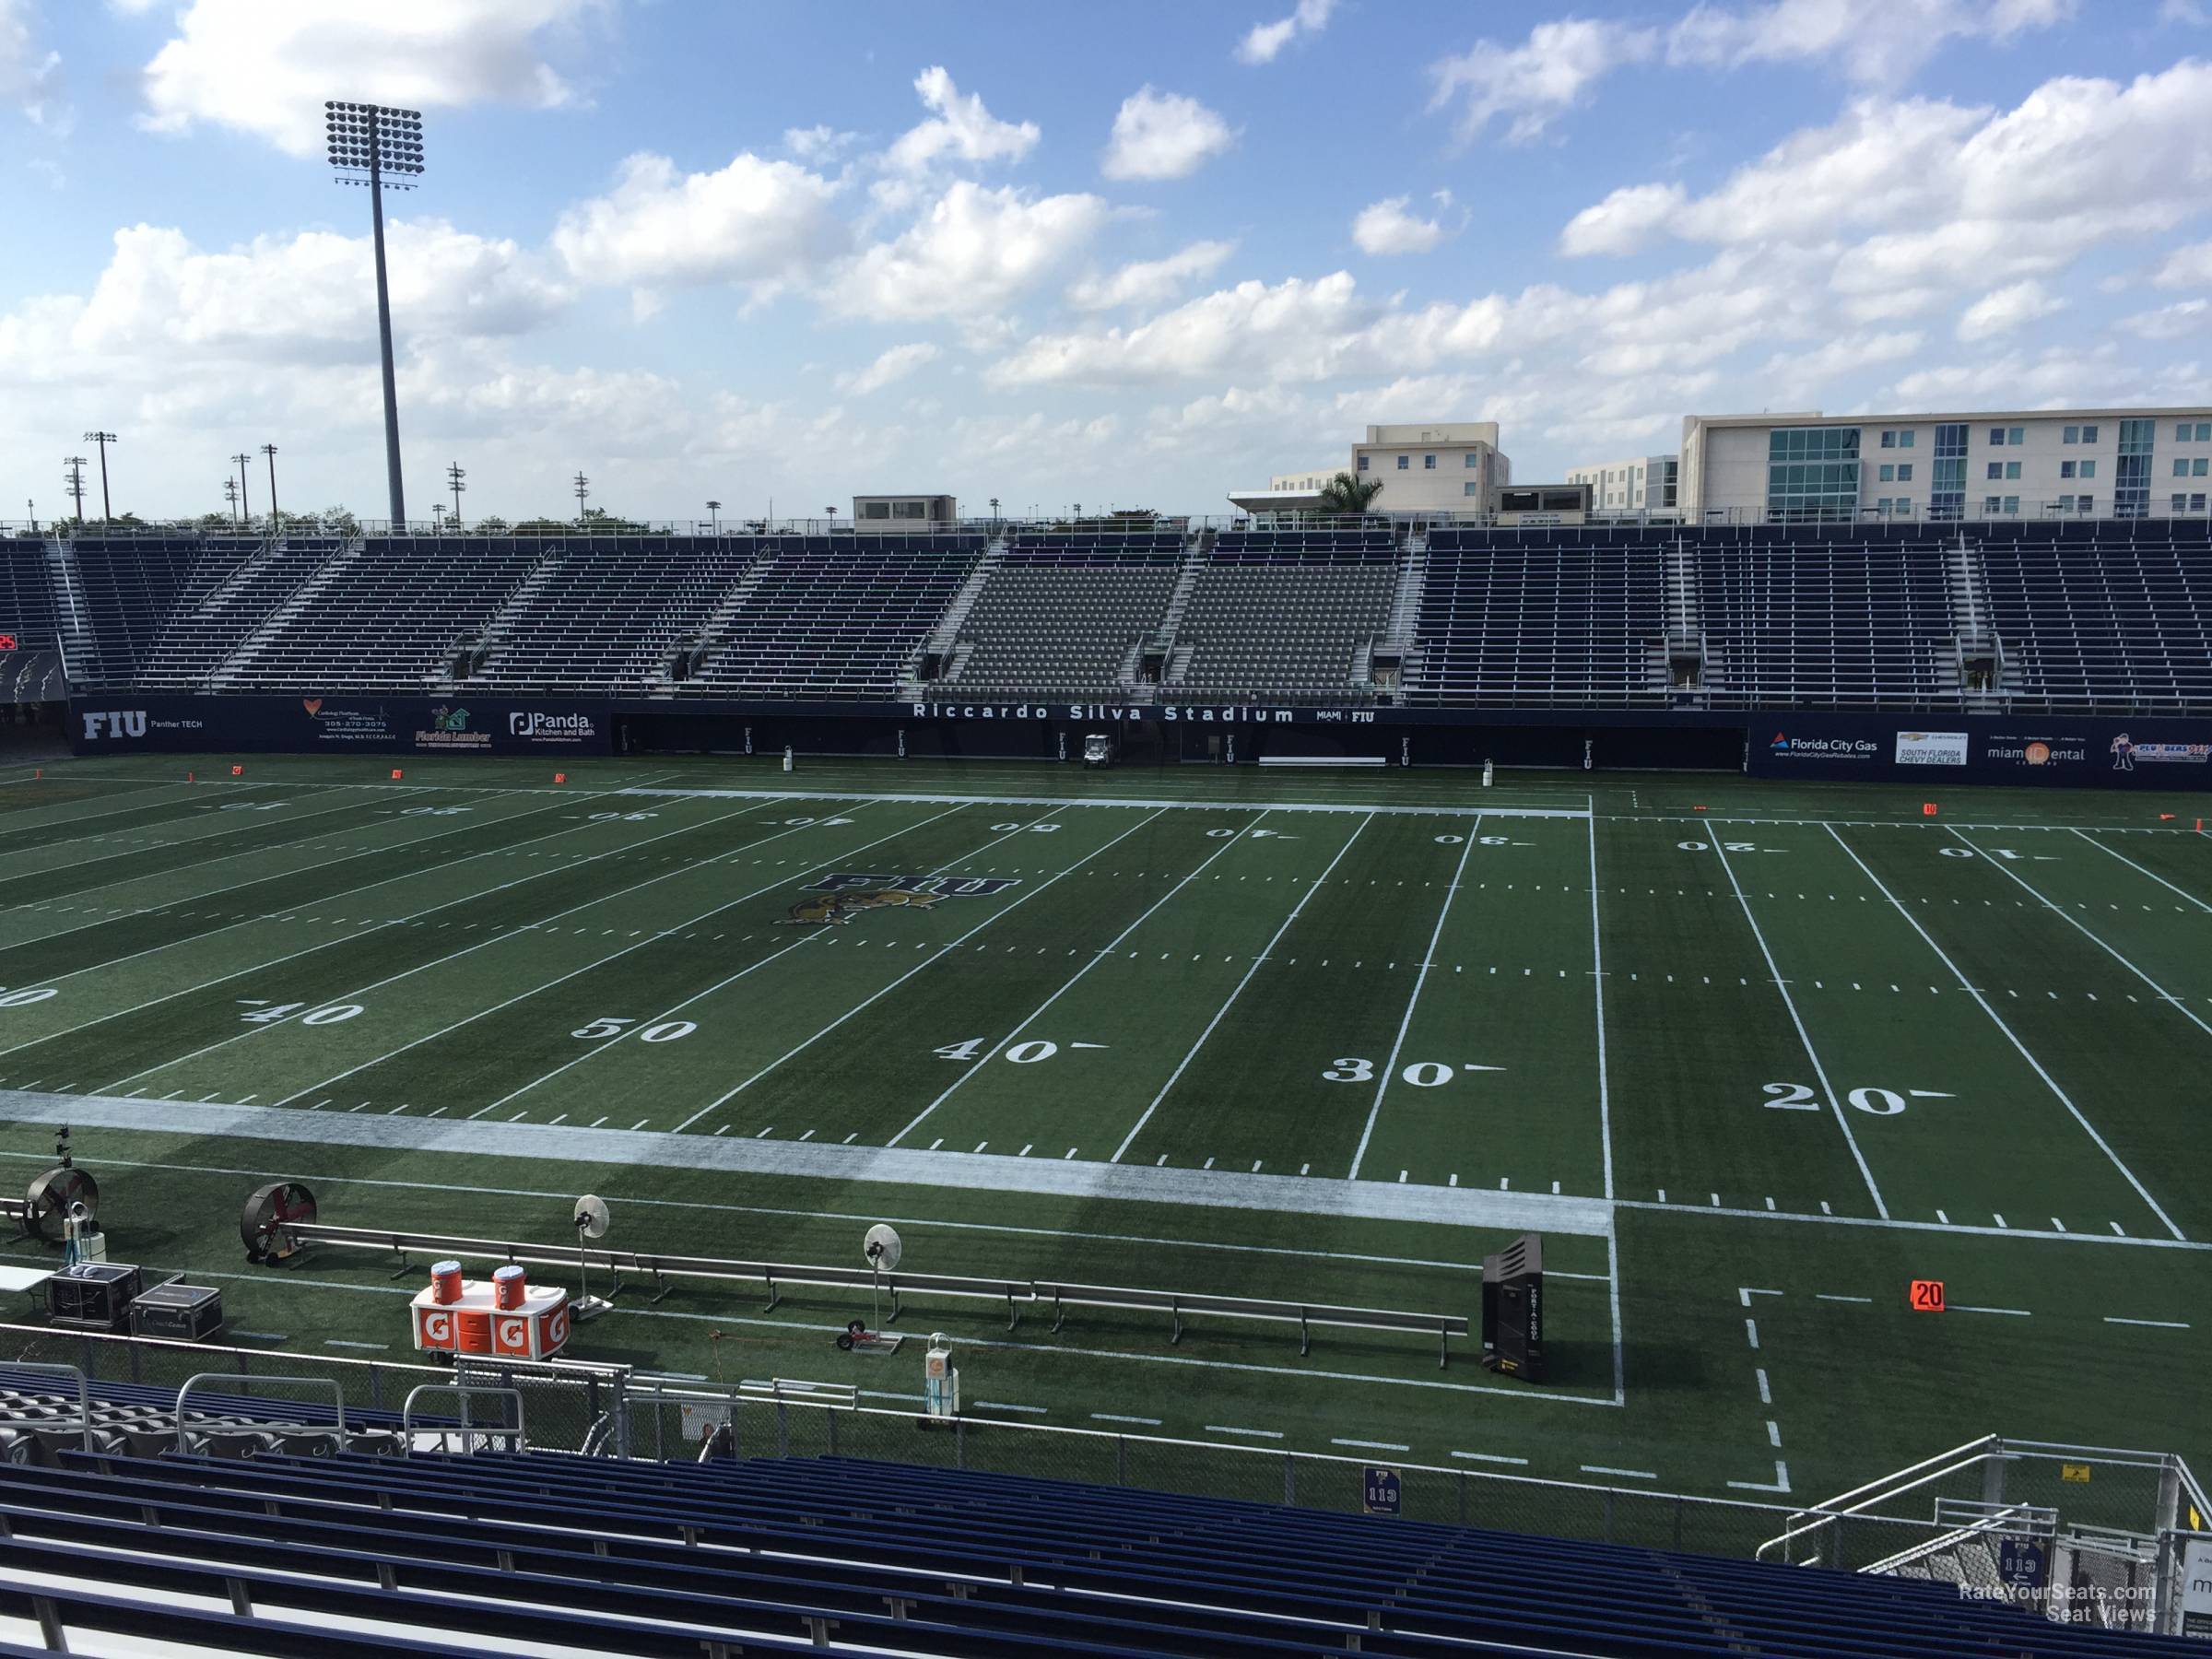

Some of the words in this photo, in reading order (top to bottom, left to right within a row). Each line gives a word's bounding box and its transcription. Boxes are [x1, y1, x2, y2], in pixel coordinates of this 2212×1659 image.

[534, 712, 589, 728] Panda
[913, 703, 1047, 718] Riccardo
[1070, 705, 1141, 720] Silva
[1164, 706, 1292, 722] Stadium
[1317, 711, 1341, 721] MIAMI
[1352, 712, 1374, 722] FIU
[83, 711, 147, 739] FIU
[416, 731, 451, 741] Florida
[452, 732, 491, 742] Lumber
[1791, 738, 1828, 749] Florida
[1830, 739, 1853, 752] City
[1855, 740, 1877, 751] Gas
[1434, 835, 1509, 845] 30
[1677, 841, 1755, 852] 20
[798, 873, 1023, 897] FIU
[241, 1002, 364, 1025] 40
[571, 1018, 697, 1042] 50
[932, 1038, 1058, 1063] 40
[1322, 1058, 1453, 1087] 30
[1762, 1082, 1906, 1115] 20
[1917, 1283, 1942, 1306] 20
[425, 1312, 449, 1341] G
[500, 1319, 524, 1347] G
[1370, 1487, 1397, 1502] 113
[2006, 1557, 2036, 1573] 113
